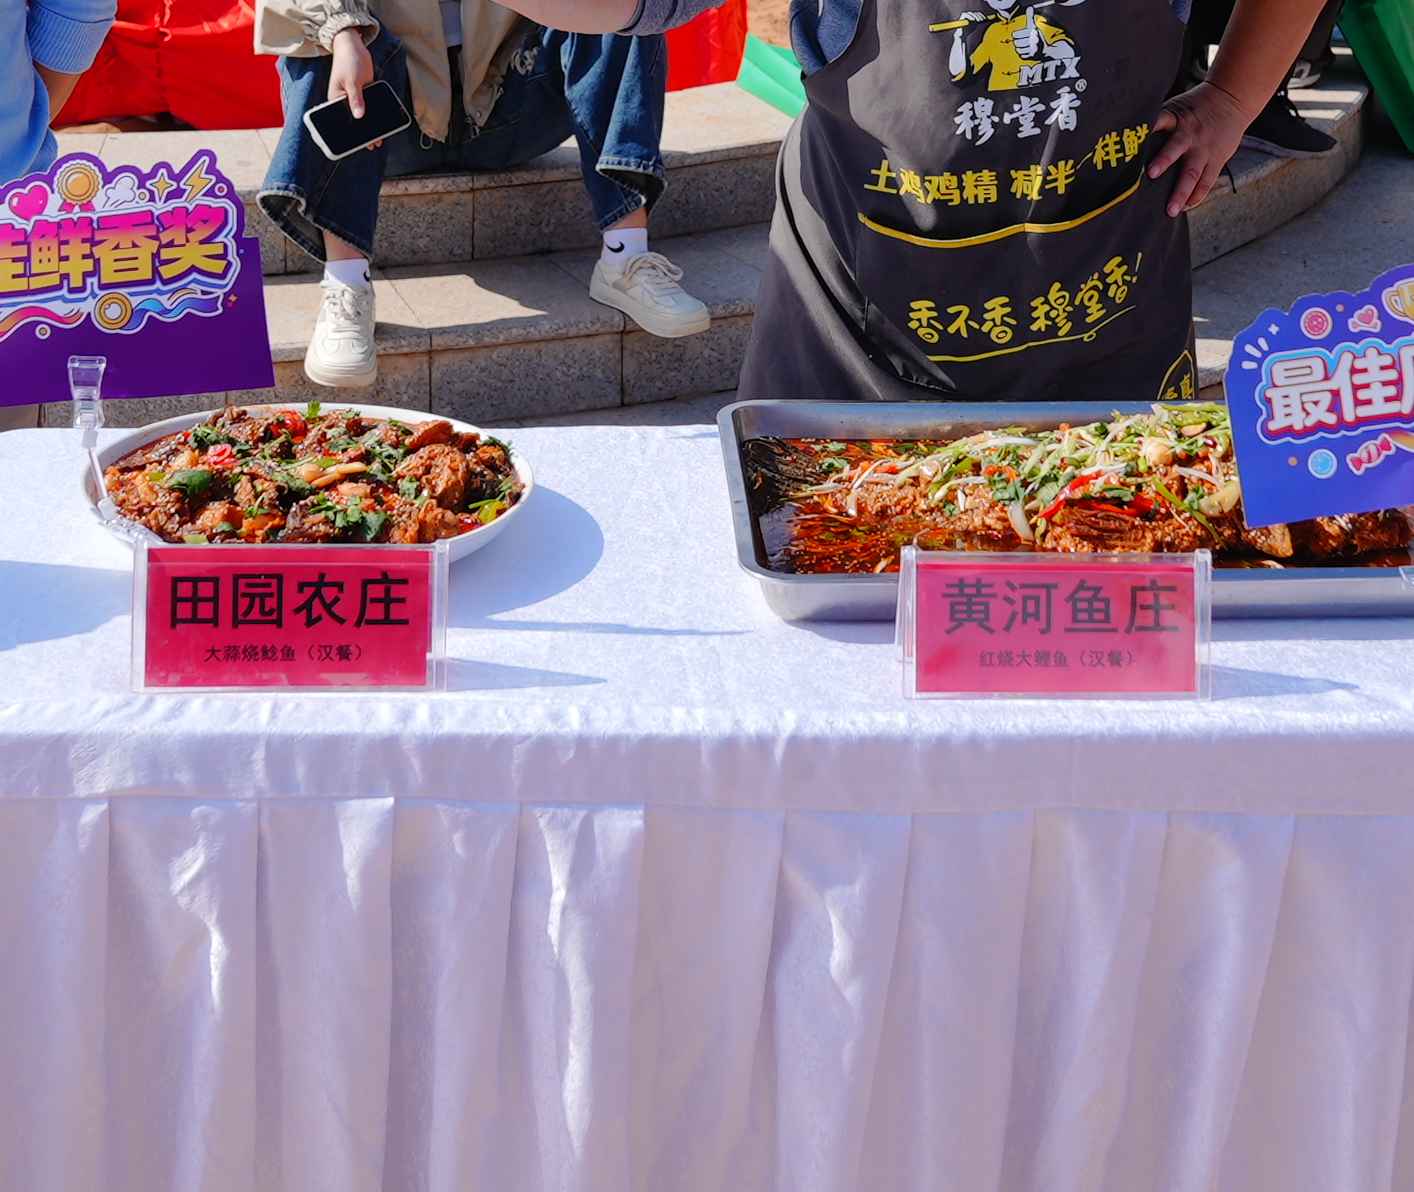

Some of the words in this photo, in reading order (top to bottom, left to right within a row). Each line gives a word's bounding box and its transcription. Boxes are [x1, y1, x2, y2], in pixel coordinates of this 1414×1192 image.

[1016, 56, 1082, 87] MTX
[953, 85, 1083, 147] 穆堂香
[863, 160, 998, 206] 土鸡鸡精
[907, 295, 1018, 345] 香不香
[169, 570, 411, 630] 田园农庄
[940, 577, 1180, 635] 黄河鱼庄
